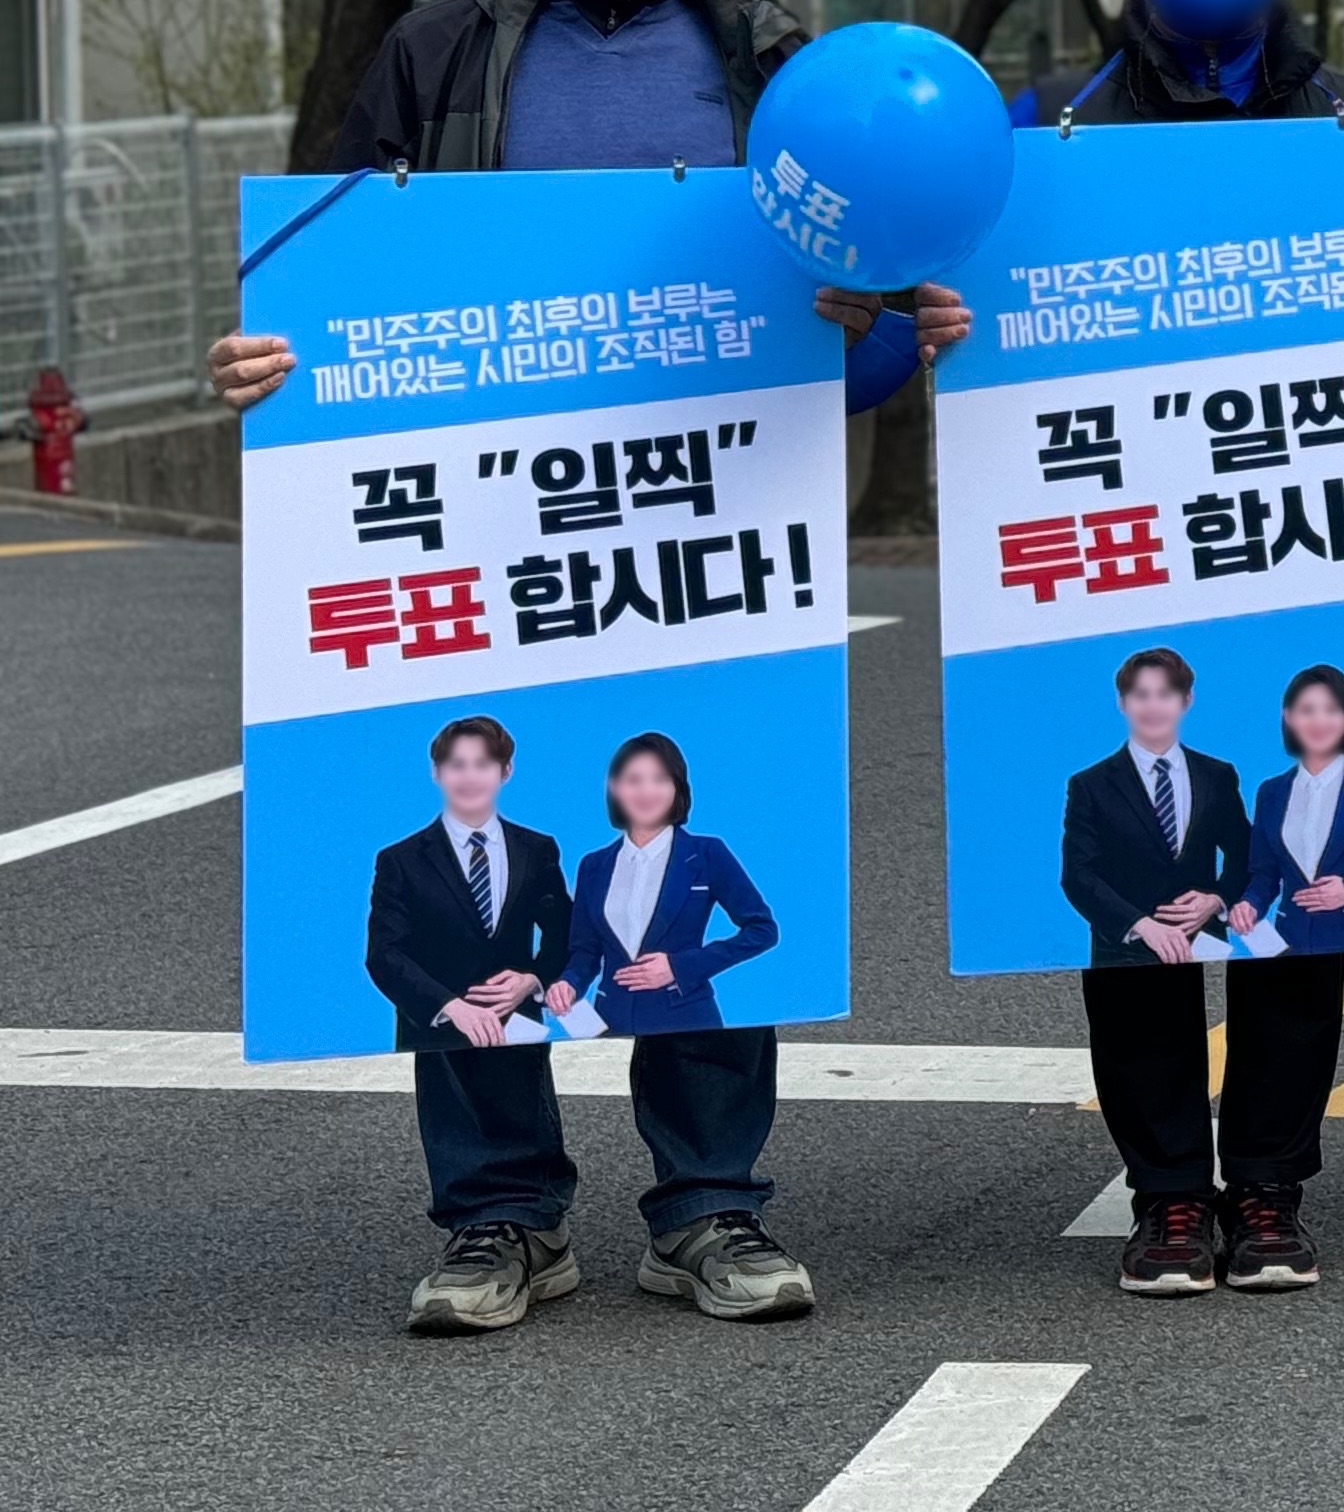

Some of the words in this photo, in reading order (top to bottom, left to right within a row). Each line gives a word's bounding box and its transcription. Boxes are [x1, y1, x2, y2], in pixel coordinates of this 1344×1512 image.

[770, 149, 851, 231] 투표
[1010, 254, 1170, 304] "민주주의
[1176, 240, 1282, 288] 최후의
[327, 306, 501, 358] "민주주의
[506, 292, 618, 341] 최후의
[629, 283, 736, 329] 보루는
[996, 300, 1140, 350] 깨어있는
[1149, 284, 1253, 333] 시민의
[314, 357, 465, 404] 깨어있는
[475, 338, 588, 388] 시민의
[596, 326, 705, 372] 조직된
[714, 318, 766, 360] 힘"
[352, 461, 442, 552] 꼭
[477, 420, 758, 536] "일찍"
[1036, 404, 1122, 490] 꼭
[308, 566, 492, 670] 투표
[506, 522, 816, 646] 합시다!
[998, 504, 1170, 604] 투표
